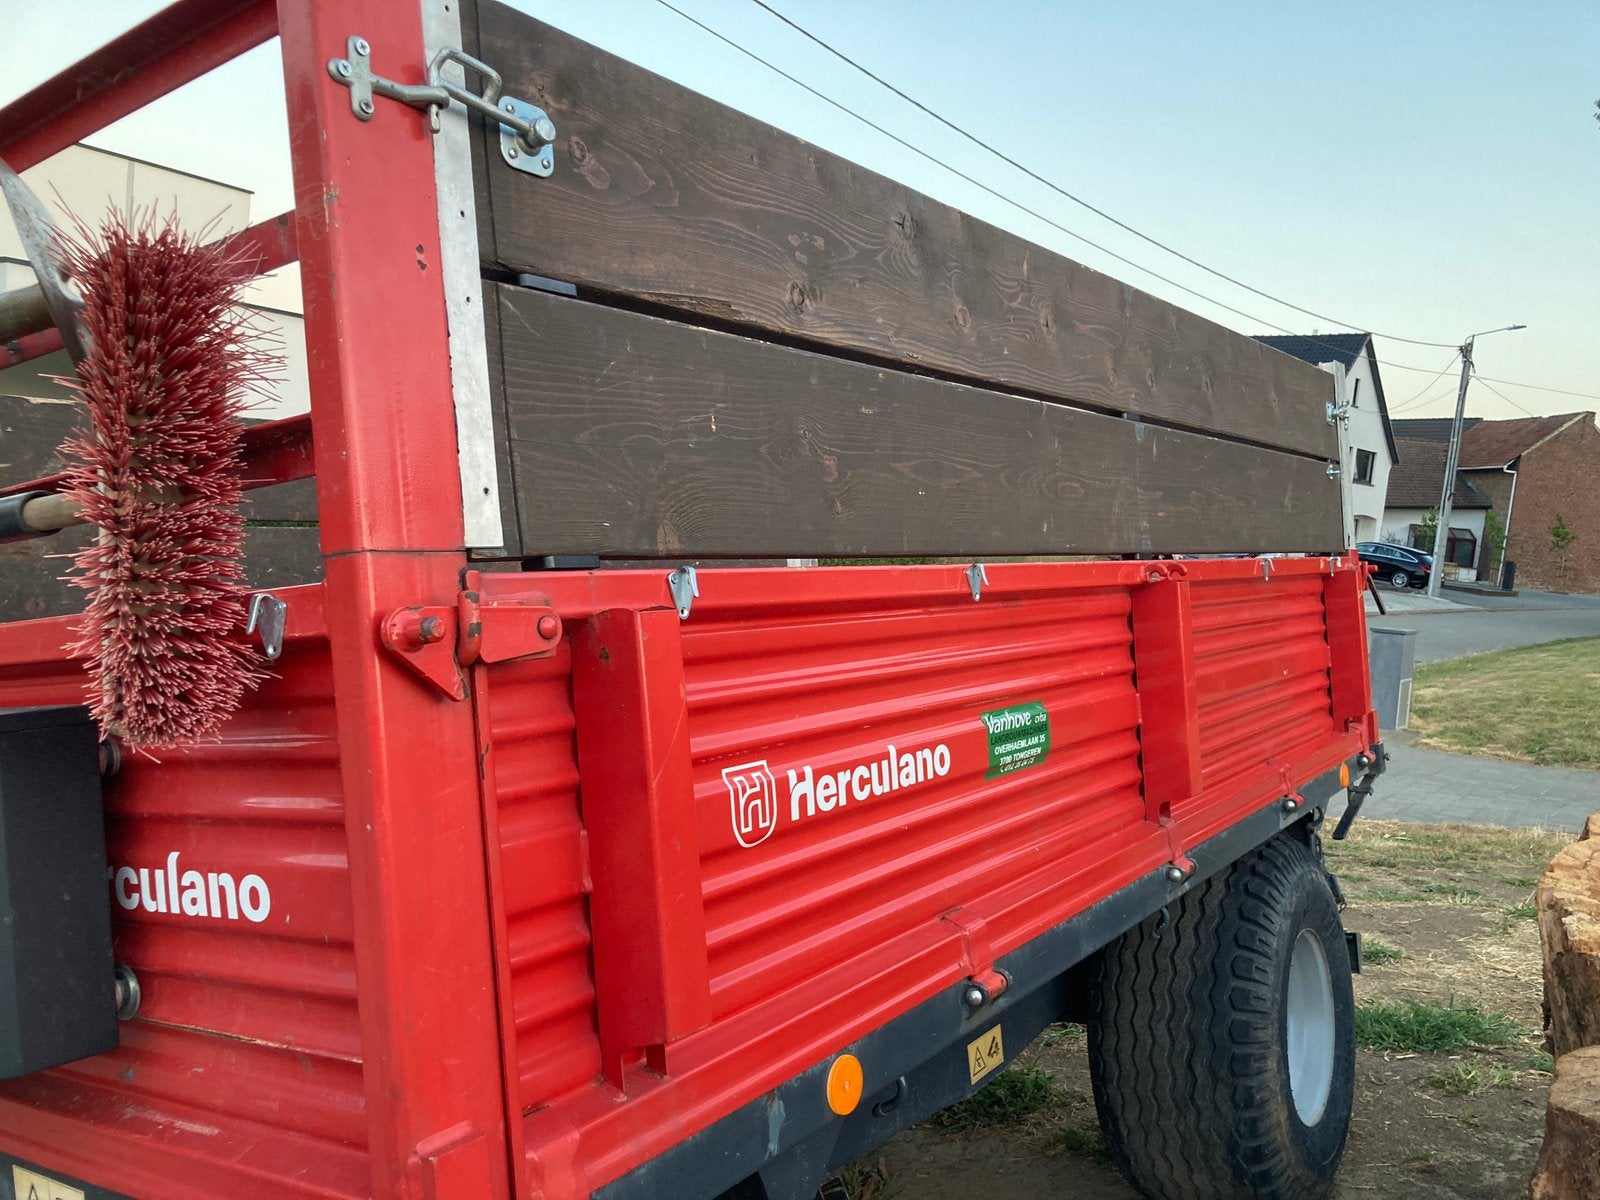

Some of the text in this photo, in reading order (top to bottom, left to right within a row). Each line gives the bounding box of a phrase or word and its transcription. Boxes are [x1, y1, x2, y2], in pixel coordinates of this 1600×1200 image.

[985, 711, 1031, 734] Vanhove
[787, 744, 951, 821] Herculano
[107, 851, 271, 923] culano
